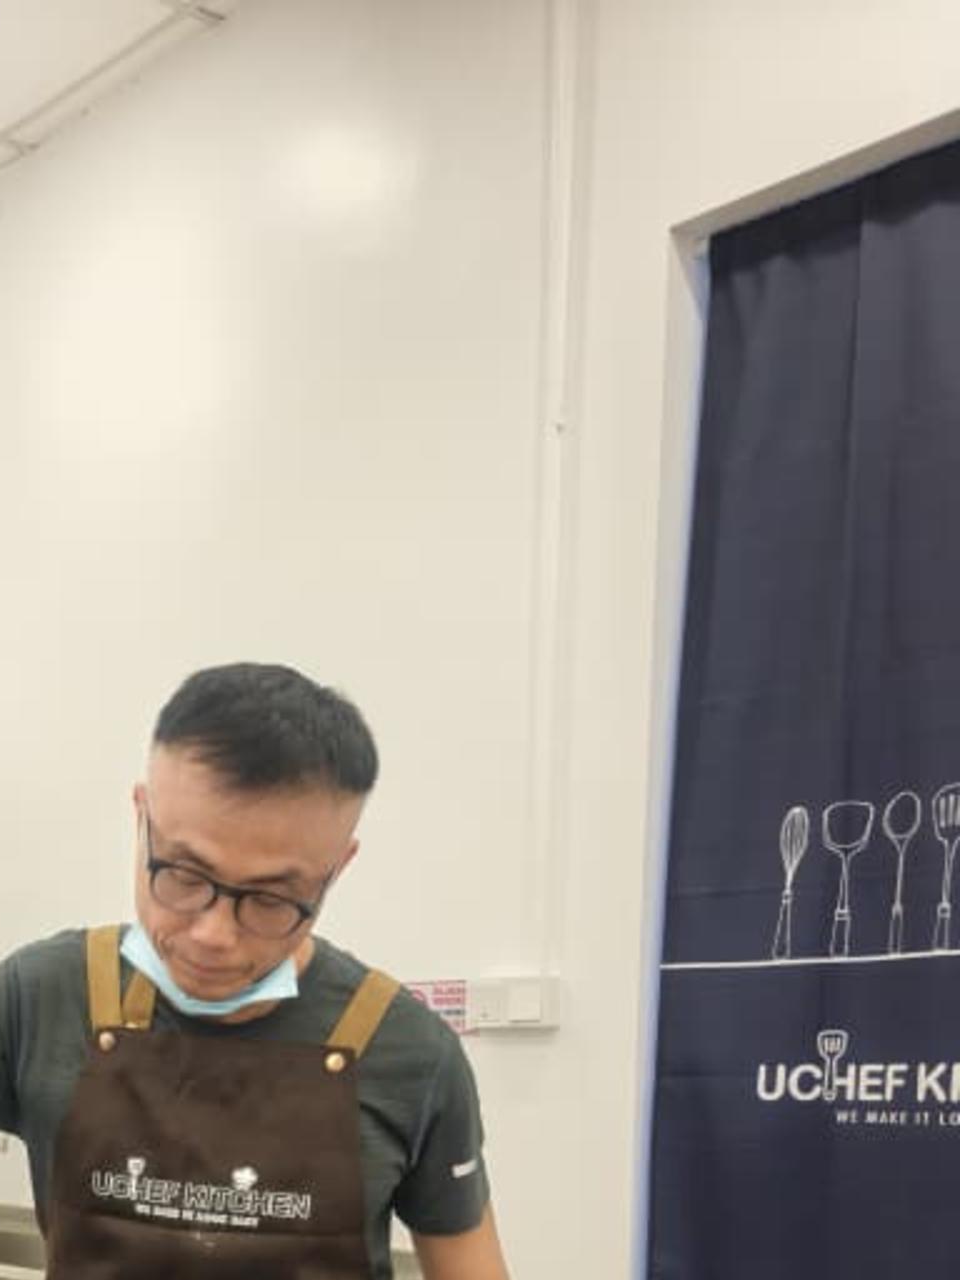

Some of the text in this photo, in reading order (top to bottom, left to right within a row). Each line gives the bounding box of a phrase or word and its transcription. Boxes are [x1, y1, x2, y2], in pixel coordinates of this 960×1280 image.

[757, 1063, 908, 1101] UCHEF
[836, 1110, 858, 1124] WE
[865, 1110, 907, 1125] MAKE
[915, 1111, 930, 1126] IT
[91, 1170, 181, 1203] UCHEF
[184, 1182, 312, 1219] KITCHEN
